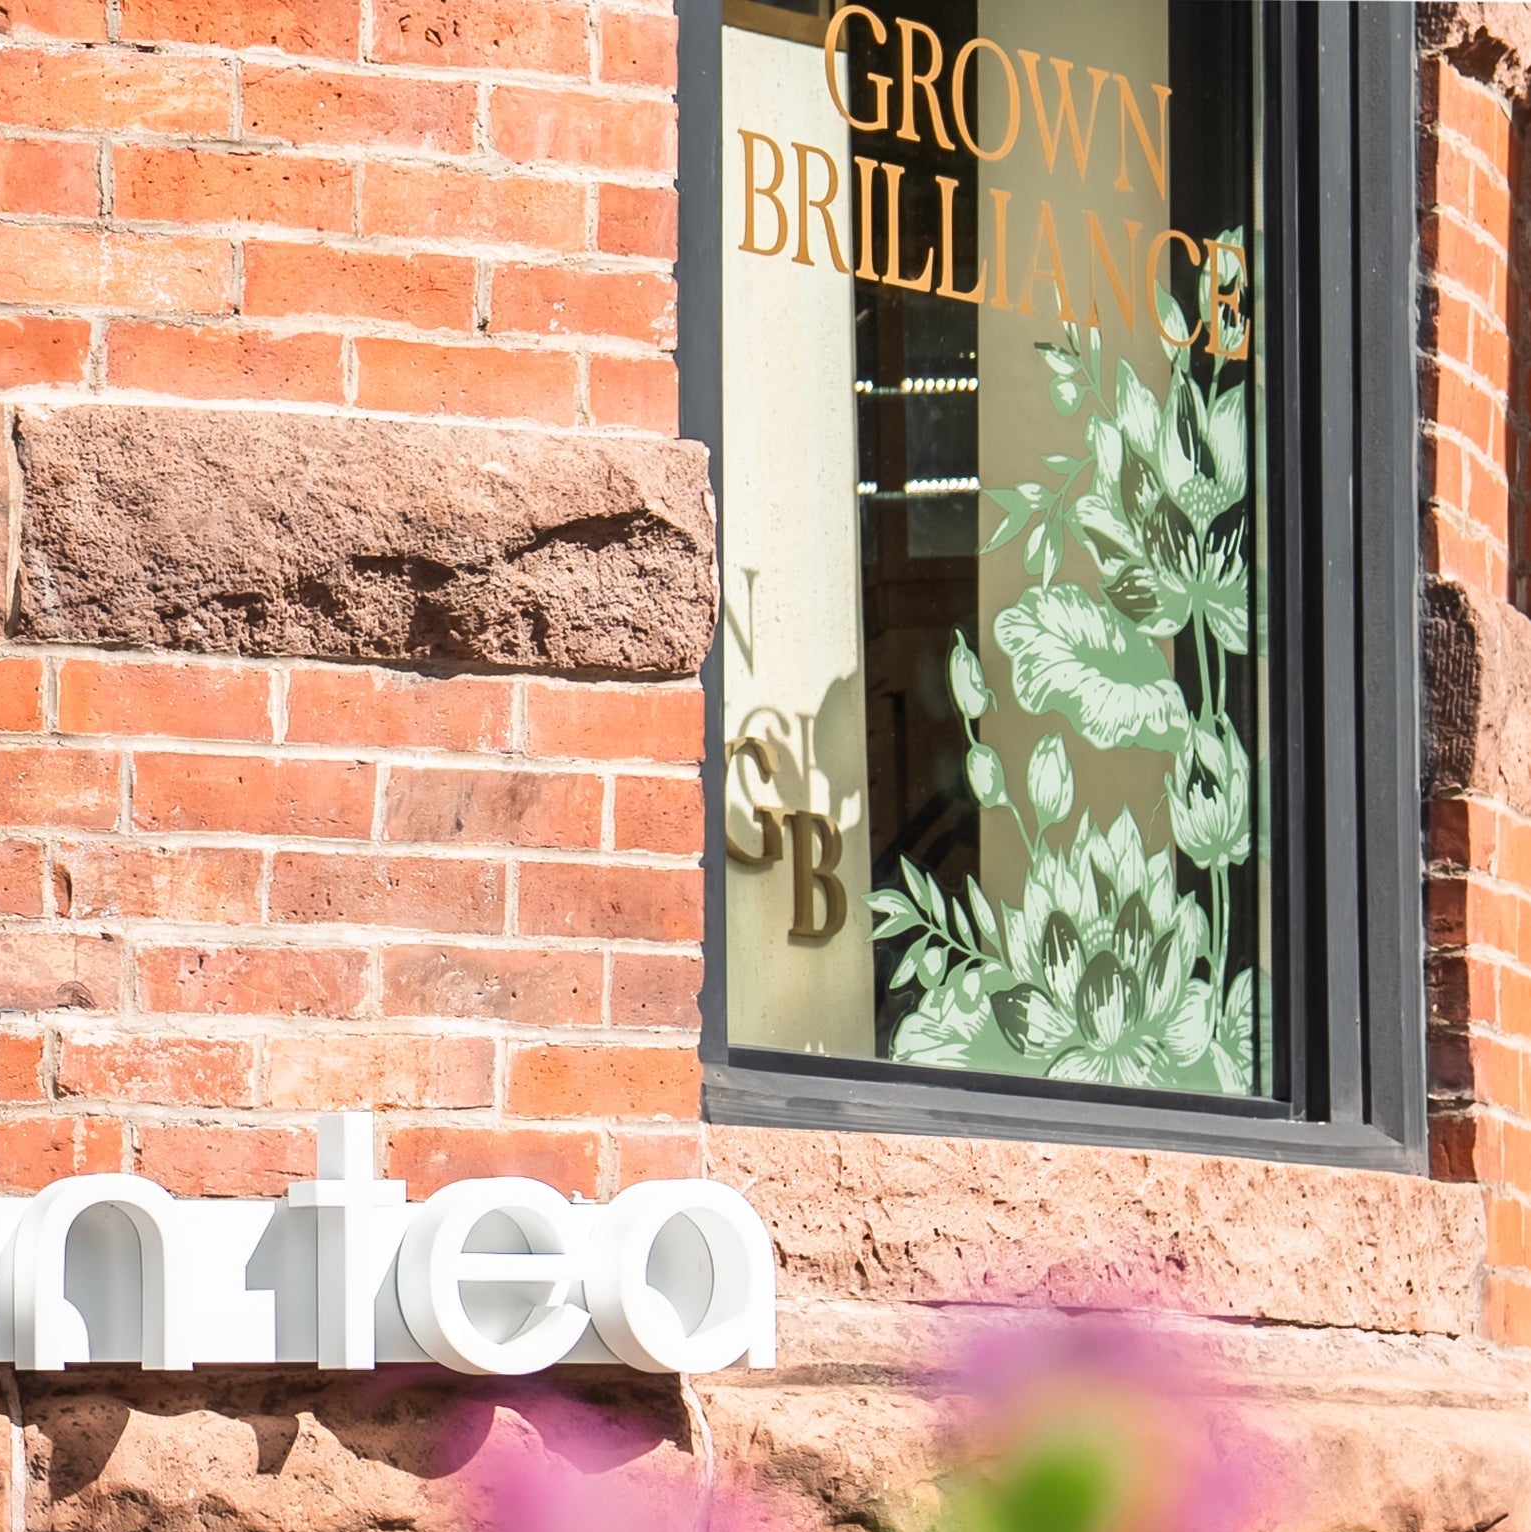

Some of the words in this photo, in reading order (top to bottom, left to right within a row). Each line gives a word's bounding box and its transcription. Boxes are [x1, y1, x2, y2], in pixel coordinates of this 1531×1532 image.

[824, 4, 1172, 200] GROWN
[738, 129, 1250, 361] BRILLIANCE
[287, 1110, 775, 1376] tea
